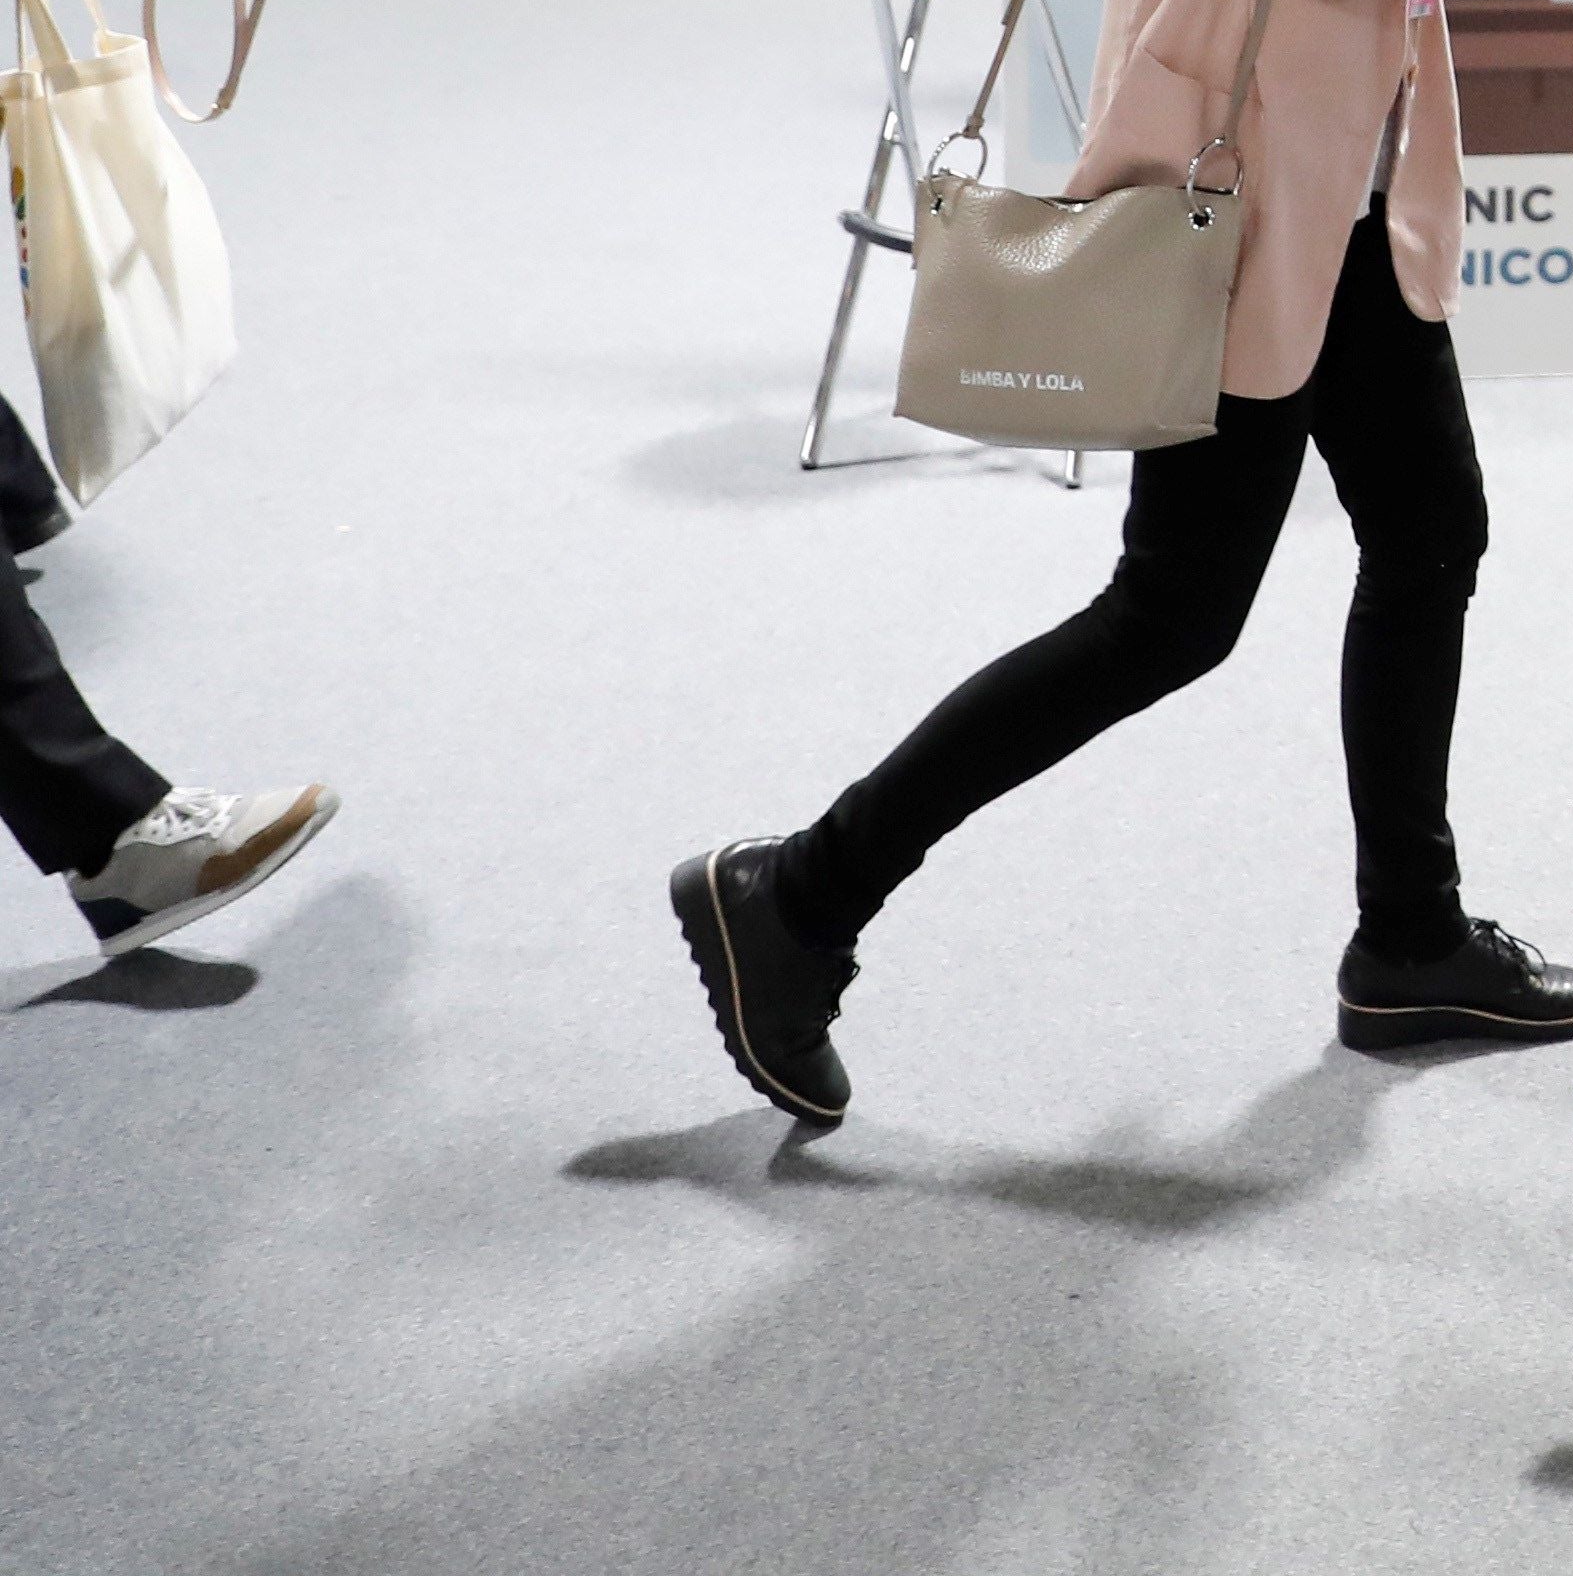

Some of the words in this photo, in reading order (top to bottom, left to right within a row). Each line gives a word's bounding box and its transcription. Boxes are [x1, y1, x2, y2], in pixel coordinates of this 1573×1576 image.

[1464, 185, 1555, 224] NIC
[960, 368, 1016, 389] BIMBA
[1018, 372, 1032, 389] Y
[1036, 373, 1085, 392] LOLA
